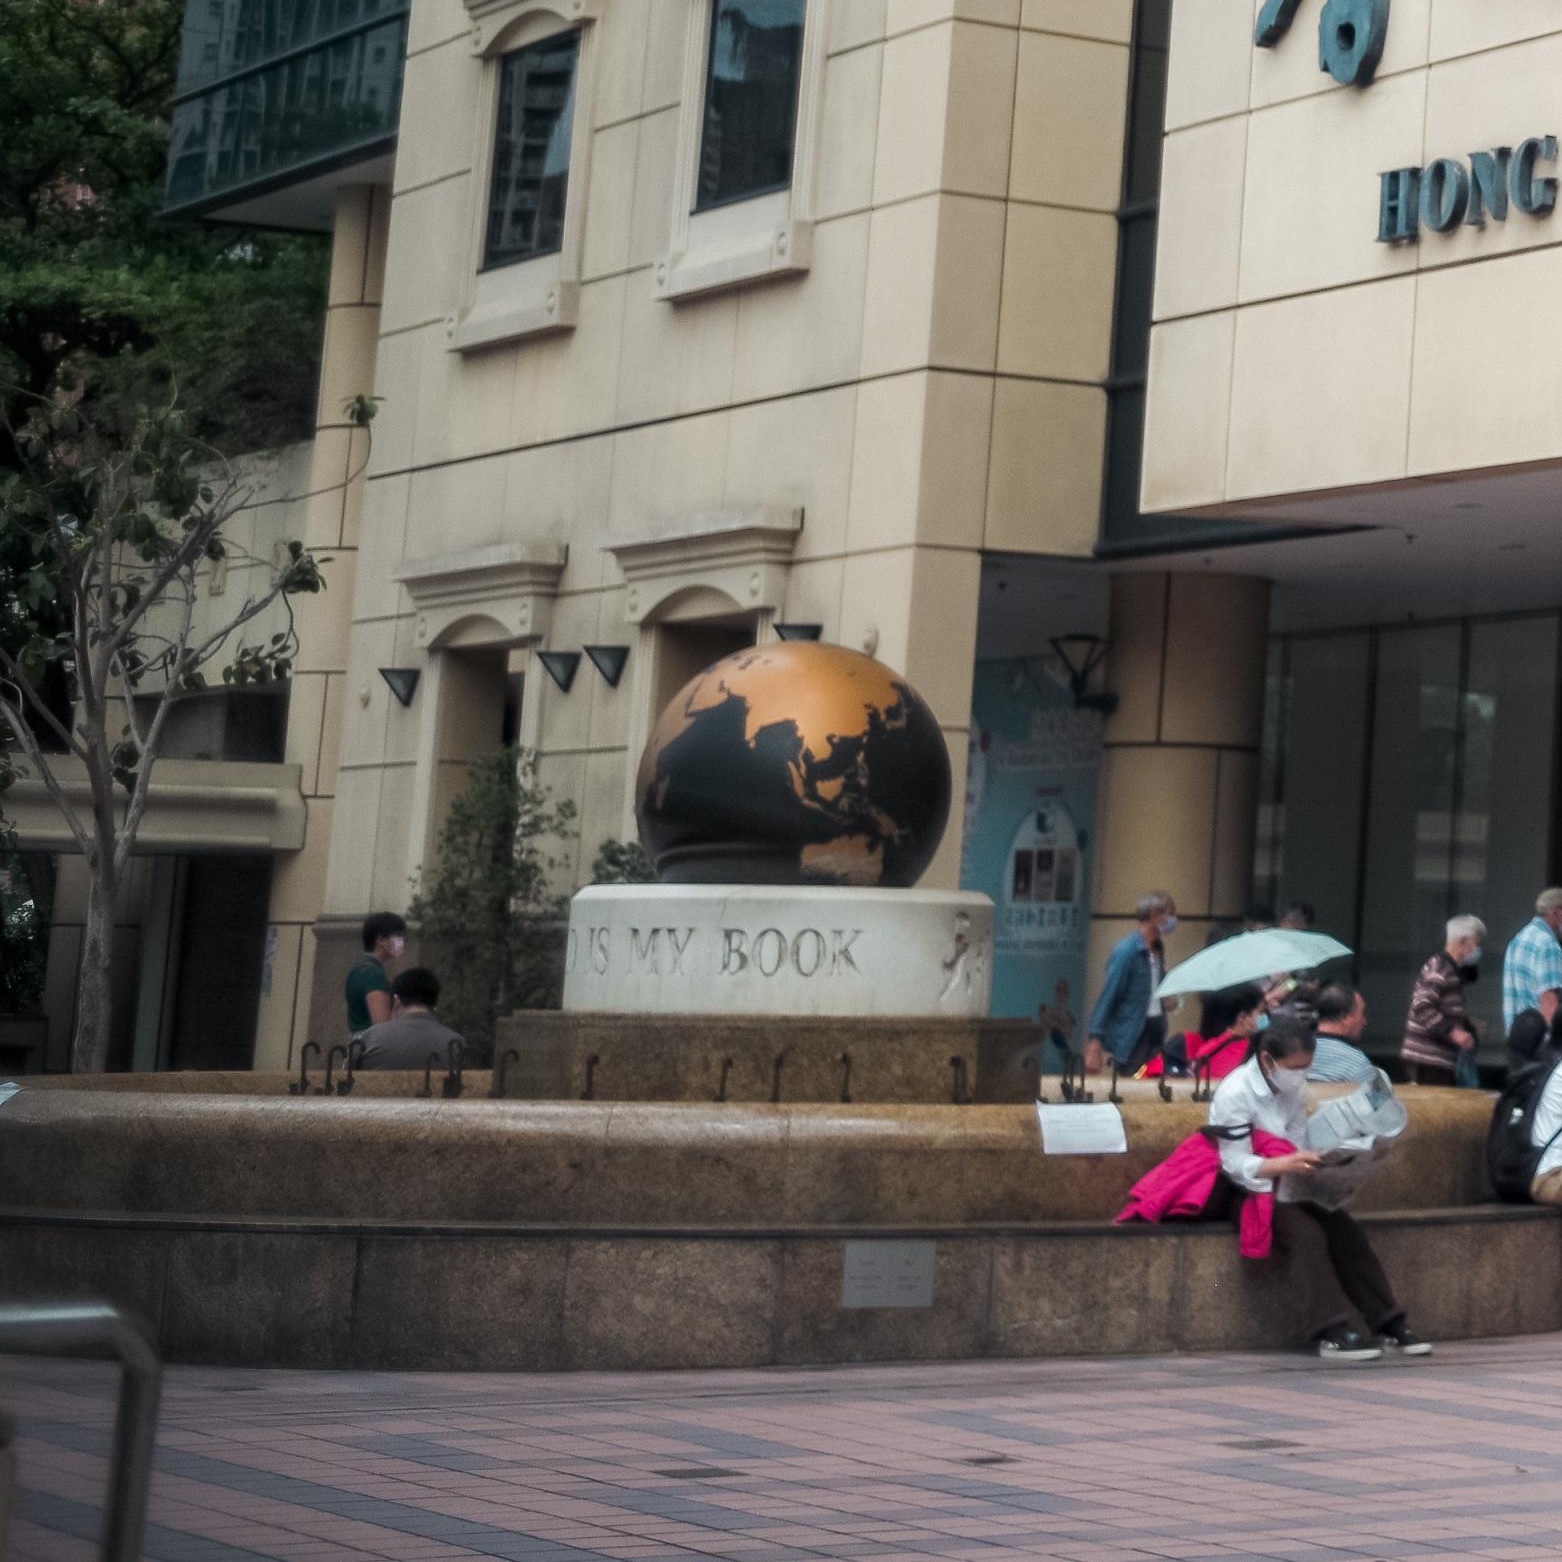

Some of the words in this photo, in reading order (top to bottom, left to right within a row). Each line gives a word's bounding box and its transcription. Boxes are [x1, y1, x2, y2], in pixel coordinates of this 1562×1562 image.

[1375, 134, 1558, 244] HONG
[625, 926, 697, 976] MY
[718, 927, 863, 978] BOOK
